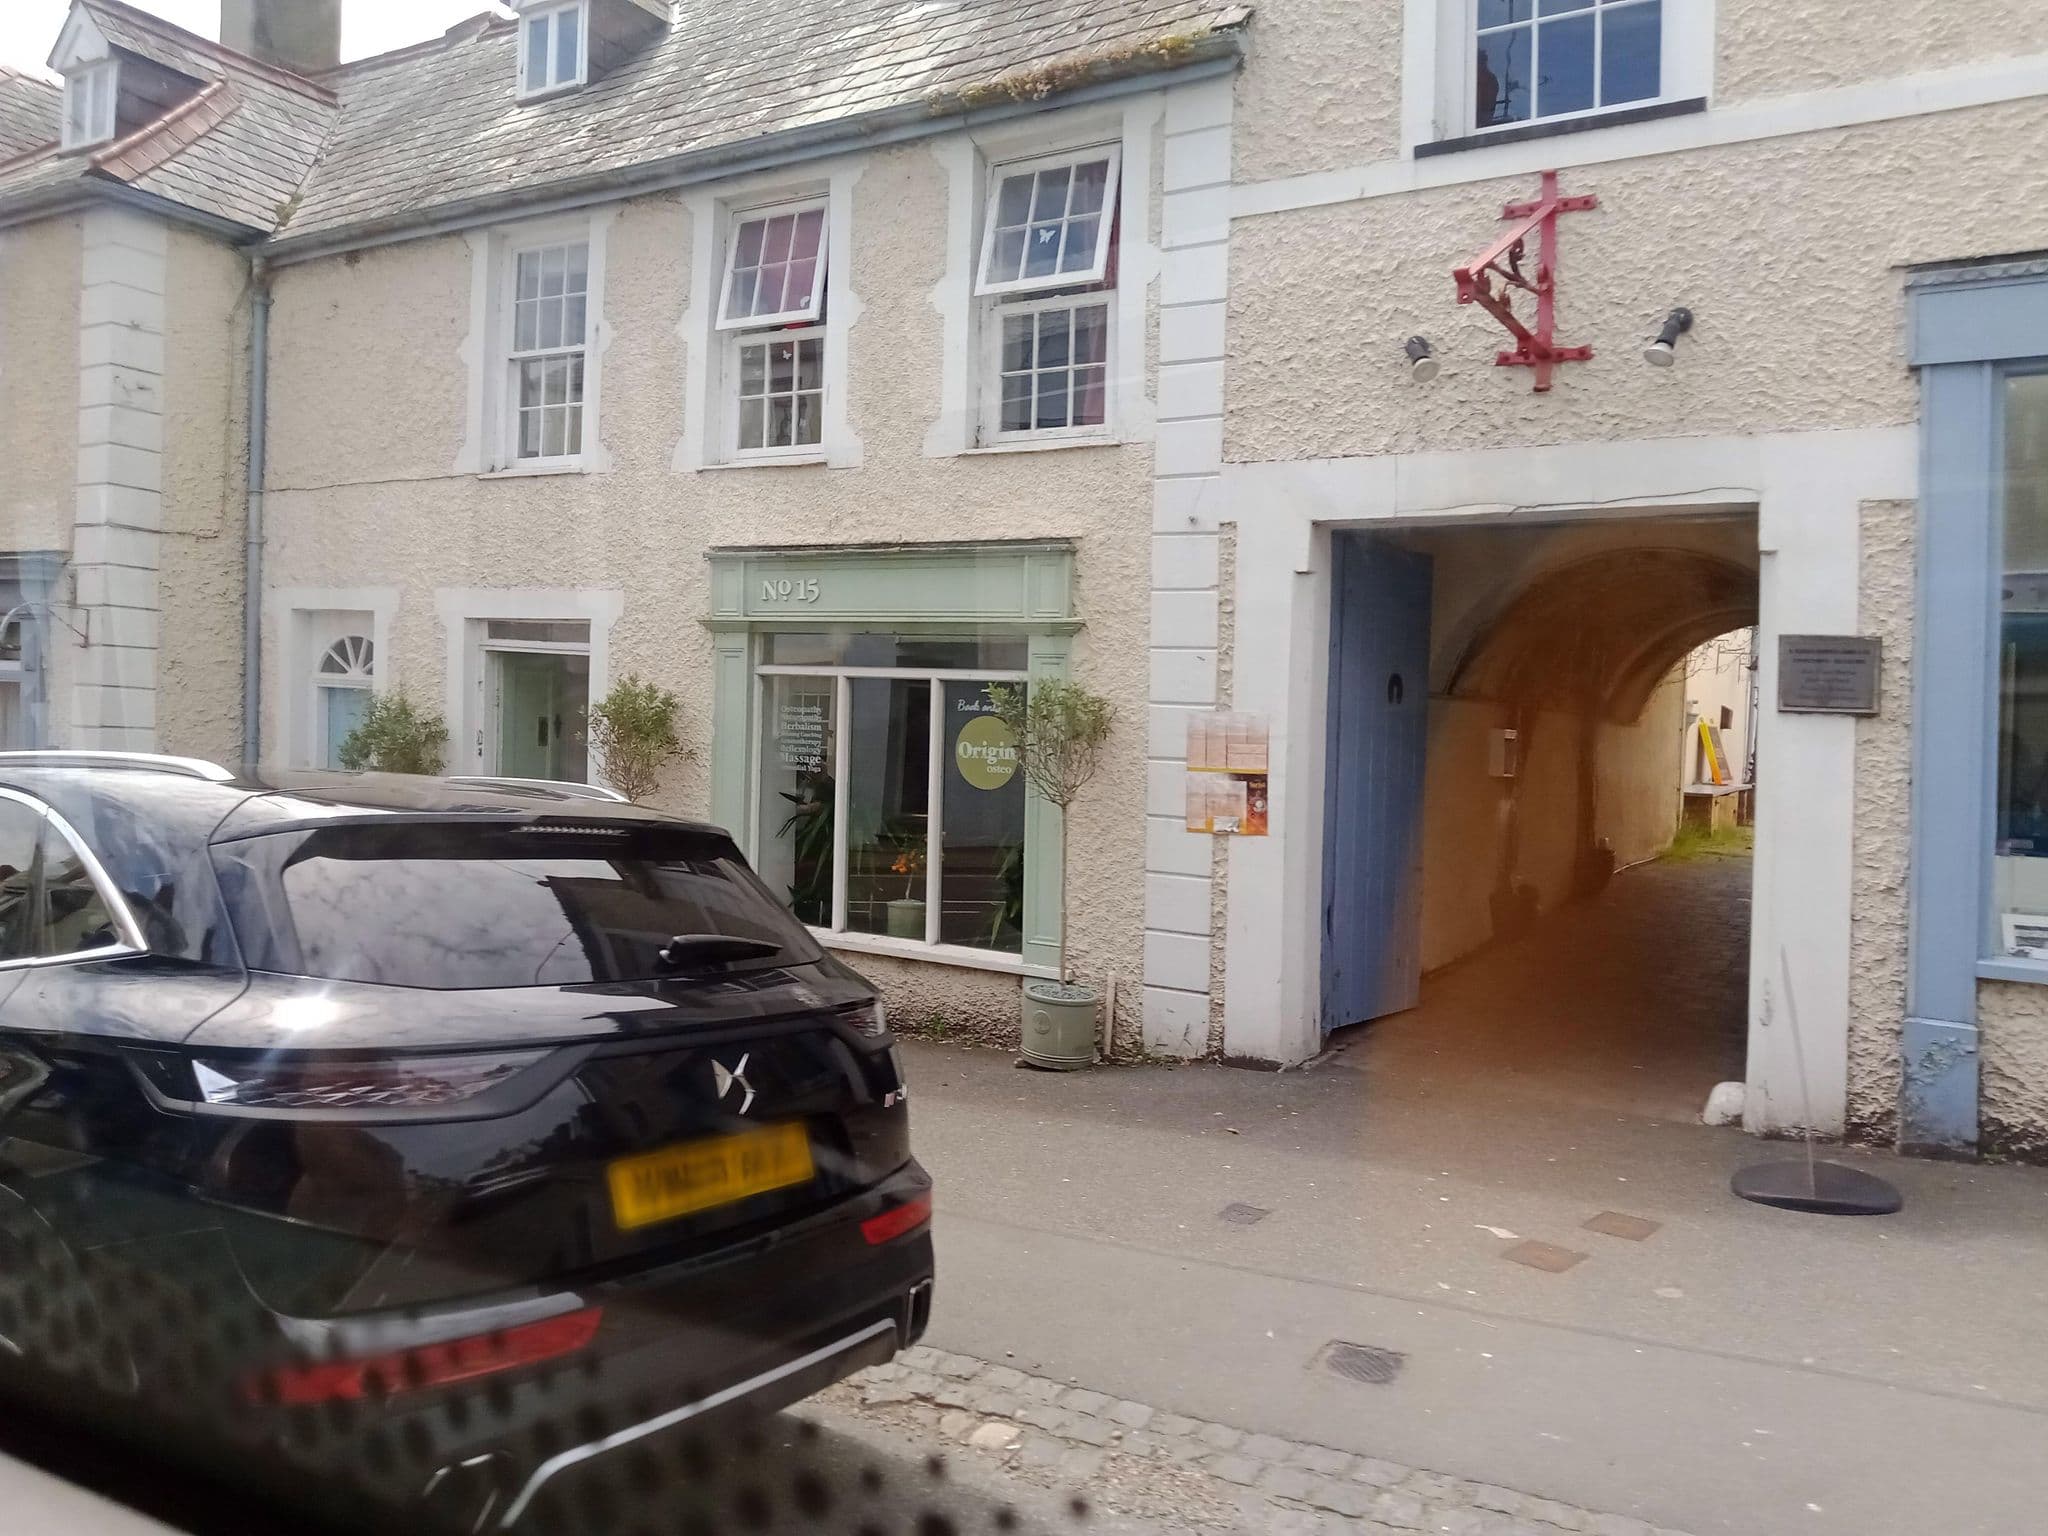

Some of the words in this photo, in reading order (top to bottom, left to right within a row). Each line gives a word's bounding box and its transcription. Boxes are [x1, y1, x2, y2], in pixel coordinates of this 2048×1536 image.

[796, 578, 821, 603] 15
[957, 699, 980, 712] Book
[781, 721, 822, 731] Herbalism
[959, 741, 1016, 764] Origin
[782, 753, 822, 766] Massage
[987, 765, 1011, 774] osteo
